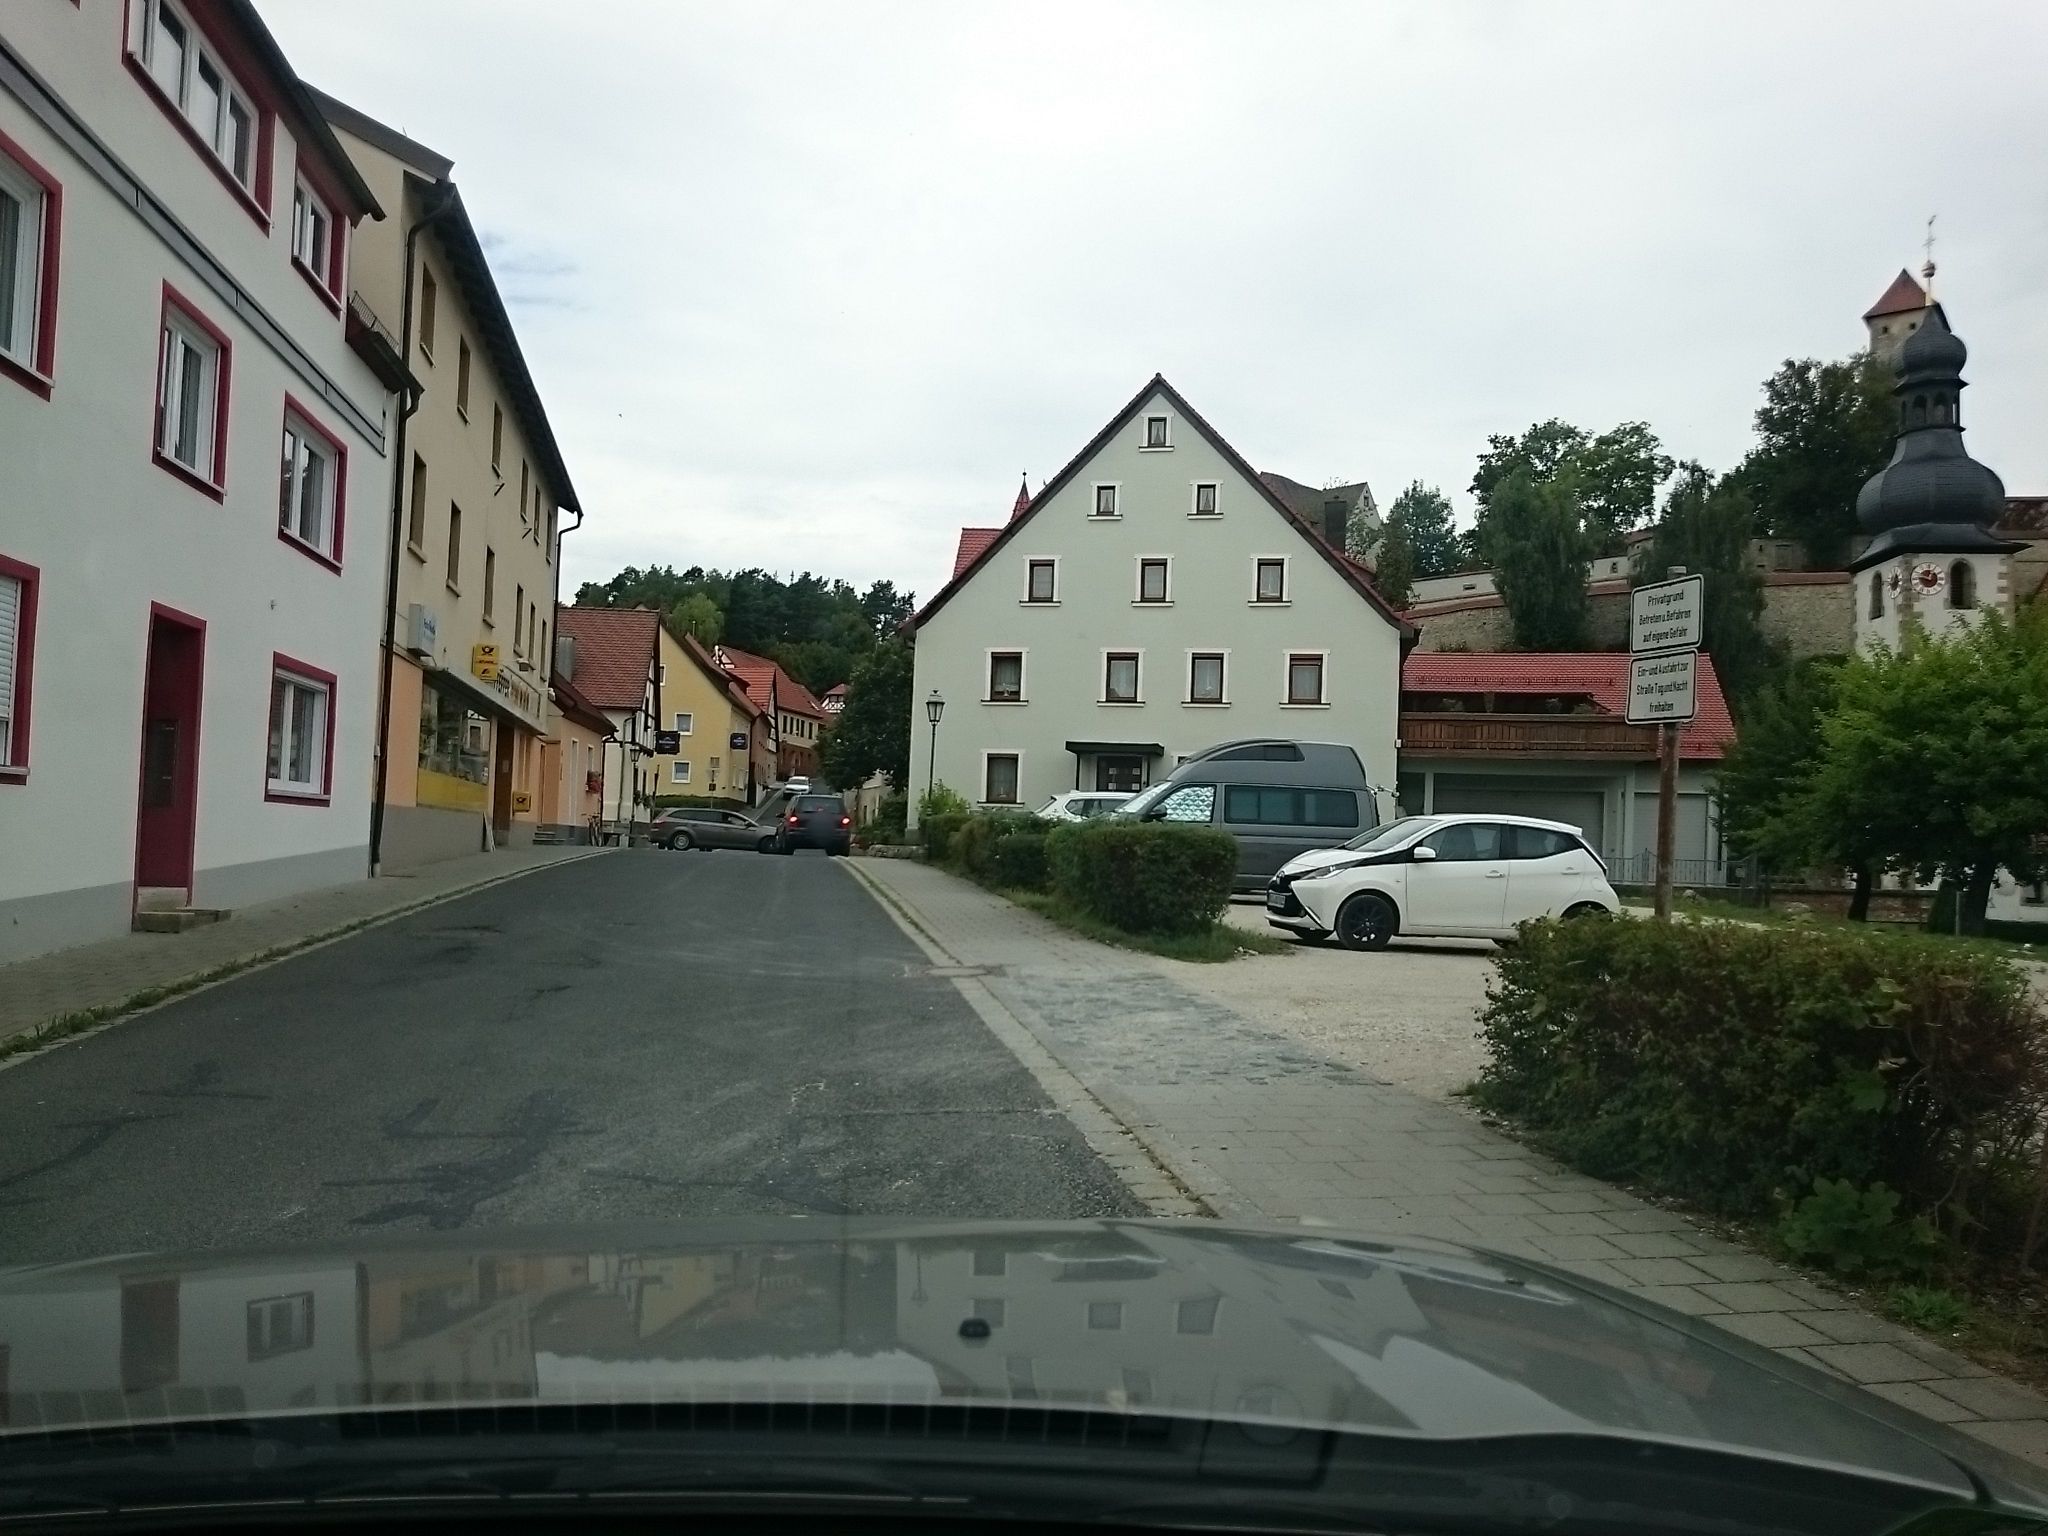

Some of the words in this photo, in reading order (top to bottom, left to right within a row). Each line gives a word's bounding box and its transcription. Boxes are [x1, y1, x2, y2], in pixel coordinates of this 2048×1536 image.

[1647, 588, 1684, 606] Privatgrund
[1639, 613, 1661, 626] Betreten
[1652, 630, 1669, 644] eigene
[1669, 626, 1688, 639] Gefahr
[1680, 662, 1688, 672] zur
[1649, 700, 1674, 713] freihalten
